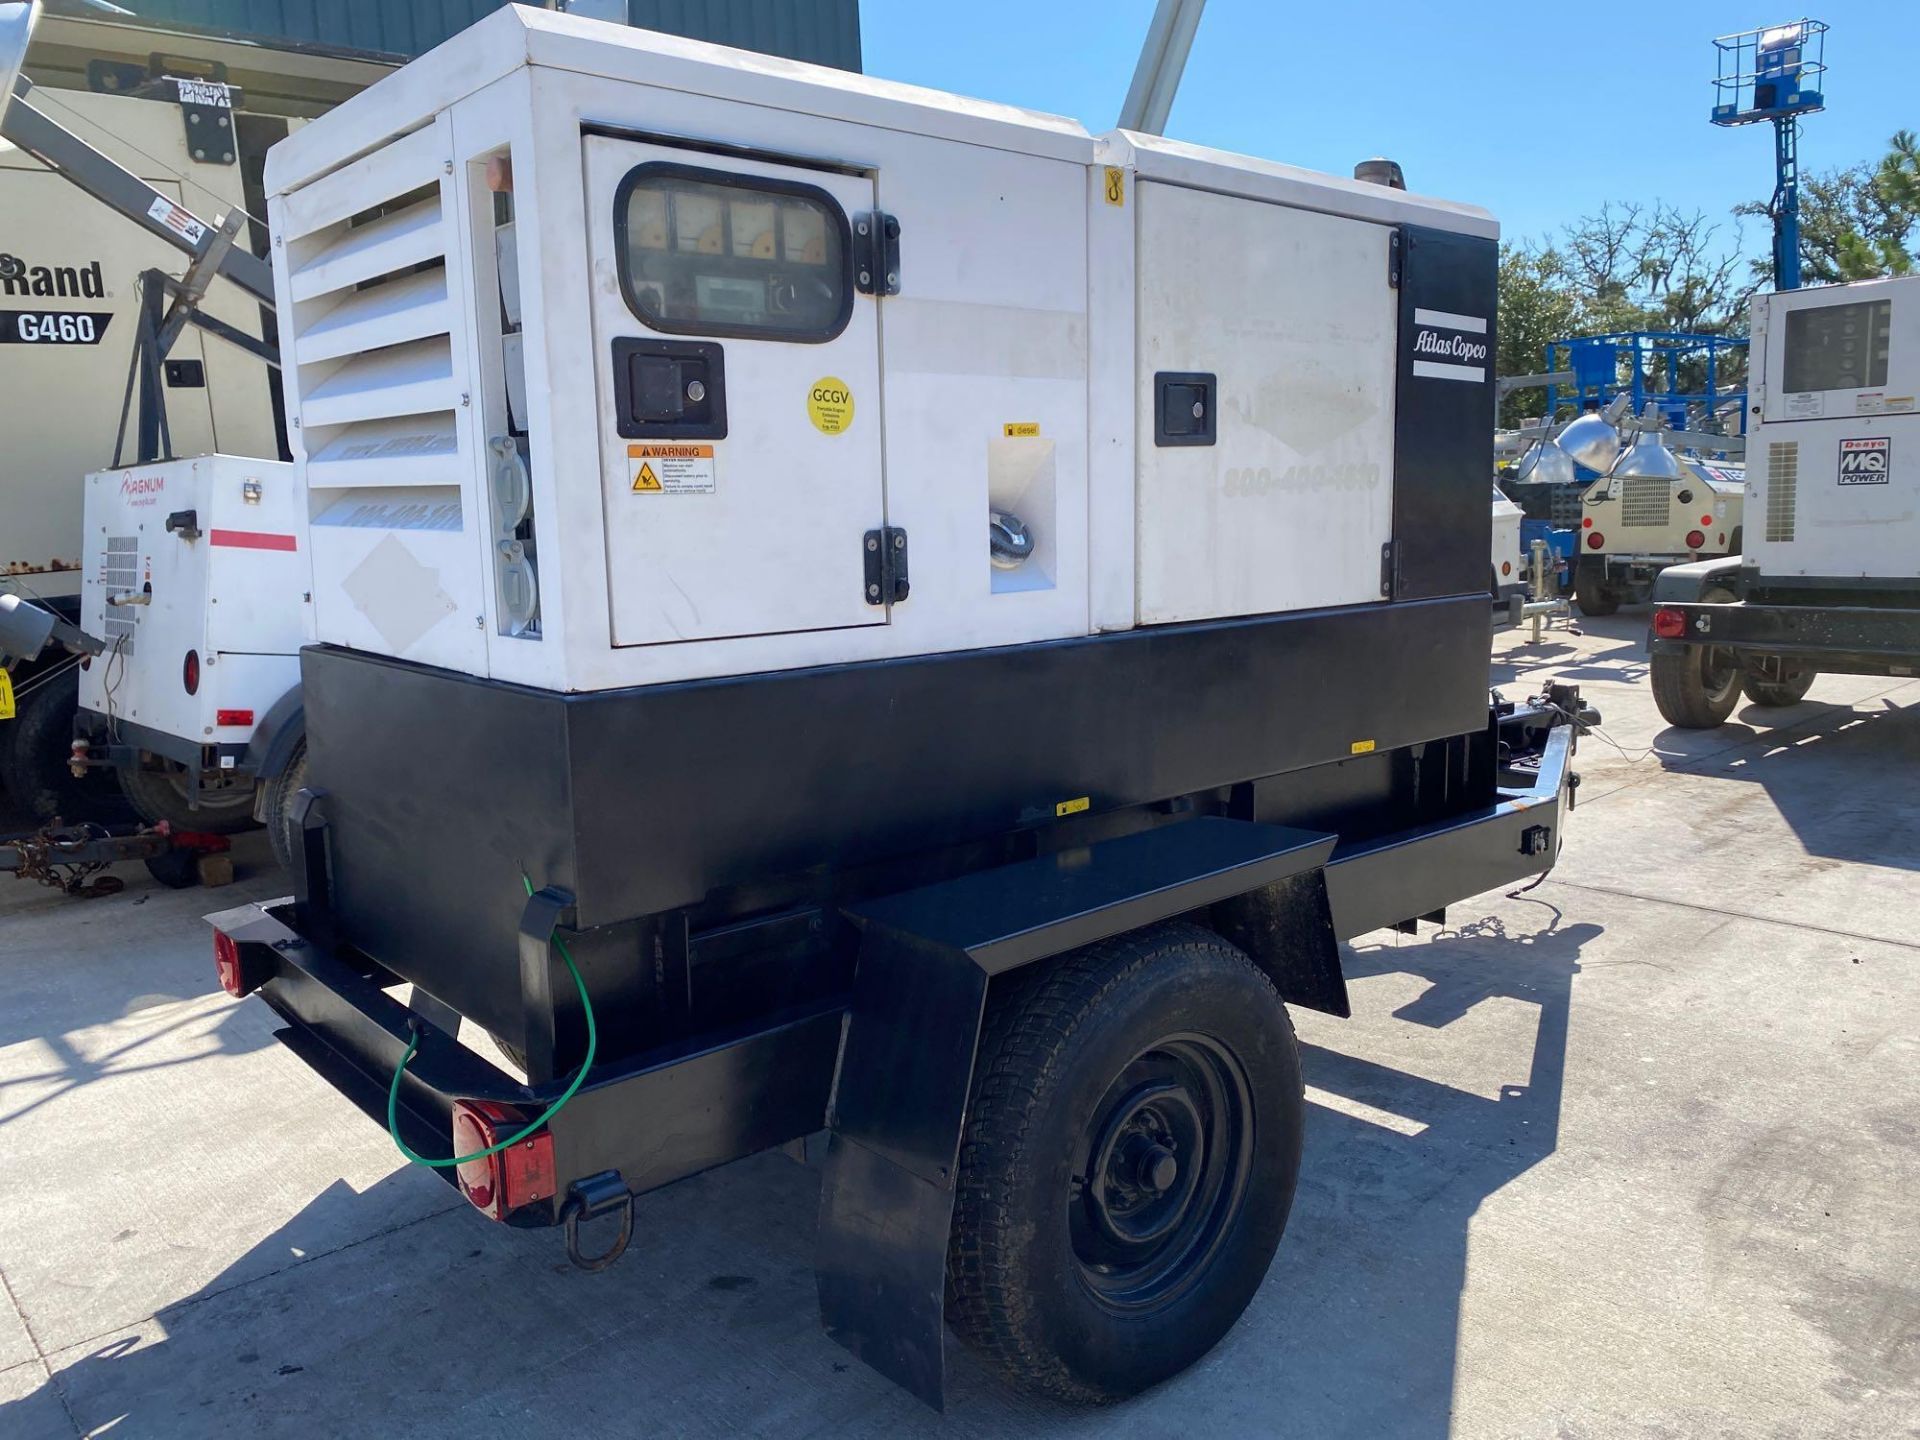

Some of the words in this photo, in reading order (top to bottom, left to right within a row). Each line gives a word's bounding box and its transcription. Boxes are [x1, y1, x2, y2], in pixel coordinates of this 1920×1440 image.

[17, 313, 95, 342] G460
[1413, 330, 1452, 355] Atlas
[1452, 335, 1487, 361] Copco
[813, 388, 849, 404] GCGV
[651, 447, 700, 457] WARNING
[1841, 452, 1885, 471] MQ
[1841, 473, 1886, 483] POWER
